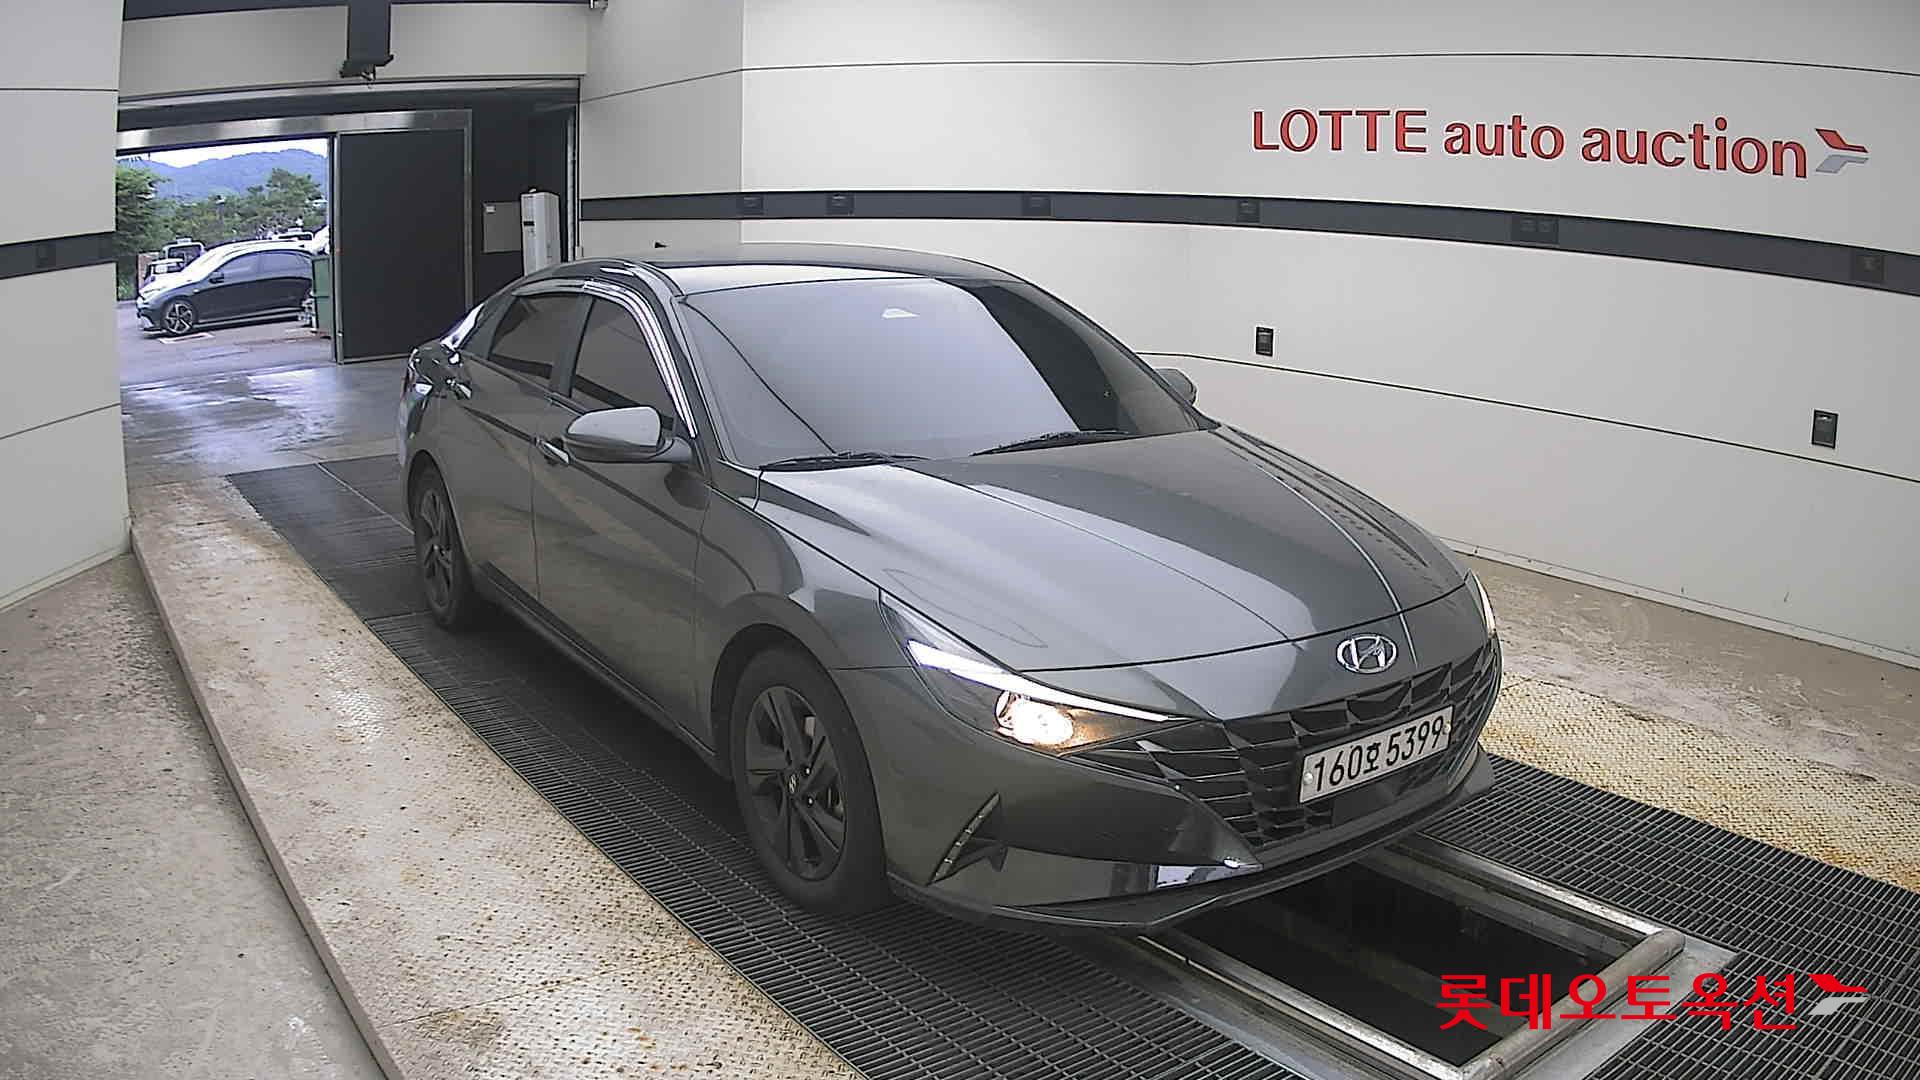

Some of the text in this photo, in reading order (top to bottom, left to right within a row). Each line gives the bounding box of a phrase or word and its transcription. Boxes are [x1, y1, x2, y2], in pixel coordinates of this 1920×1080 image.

[1253, 110, 1808, 179] LOTTE auto auction
